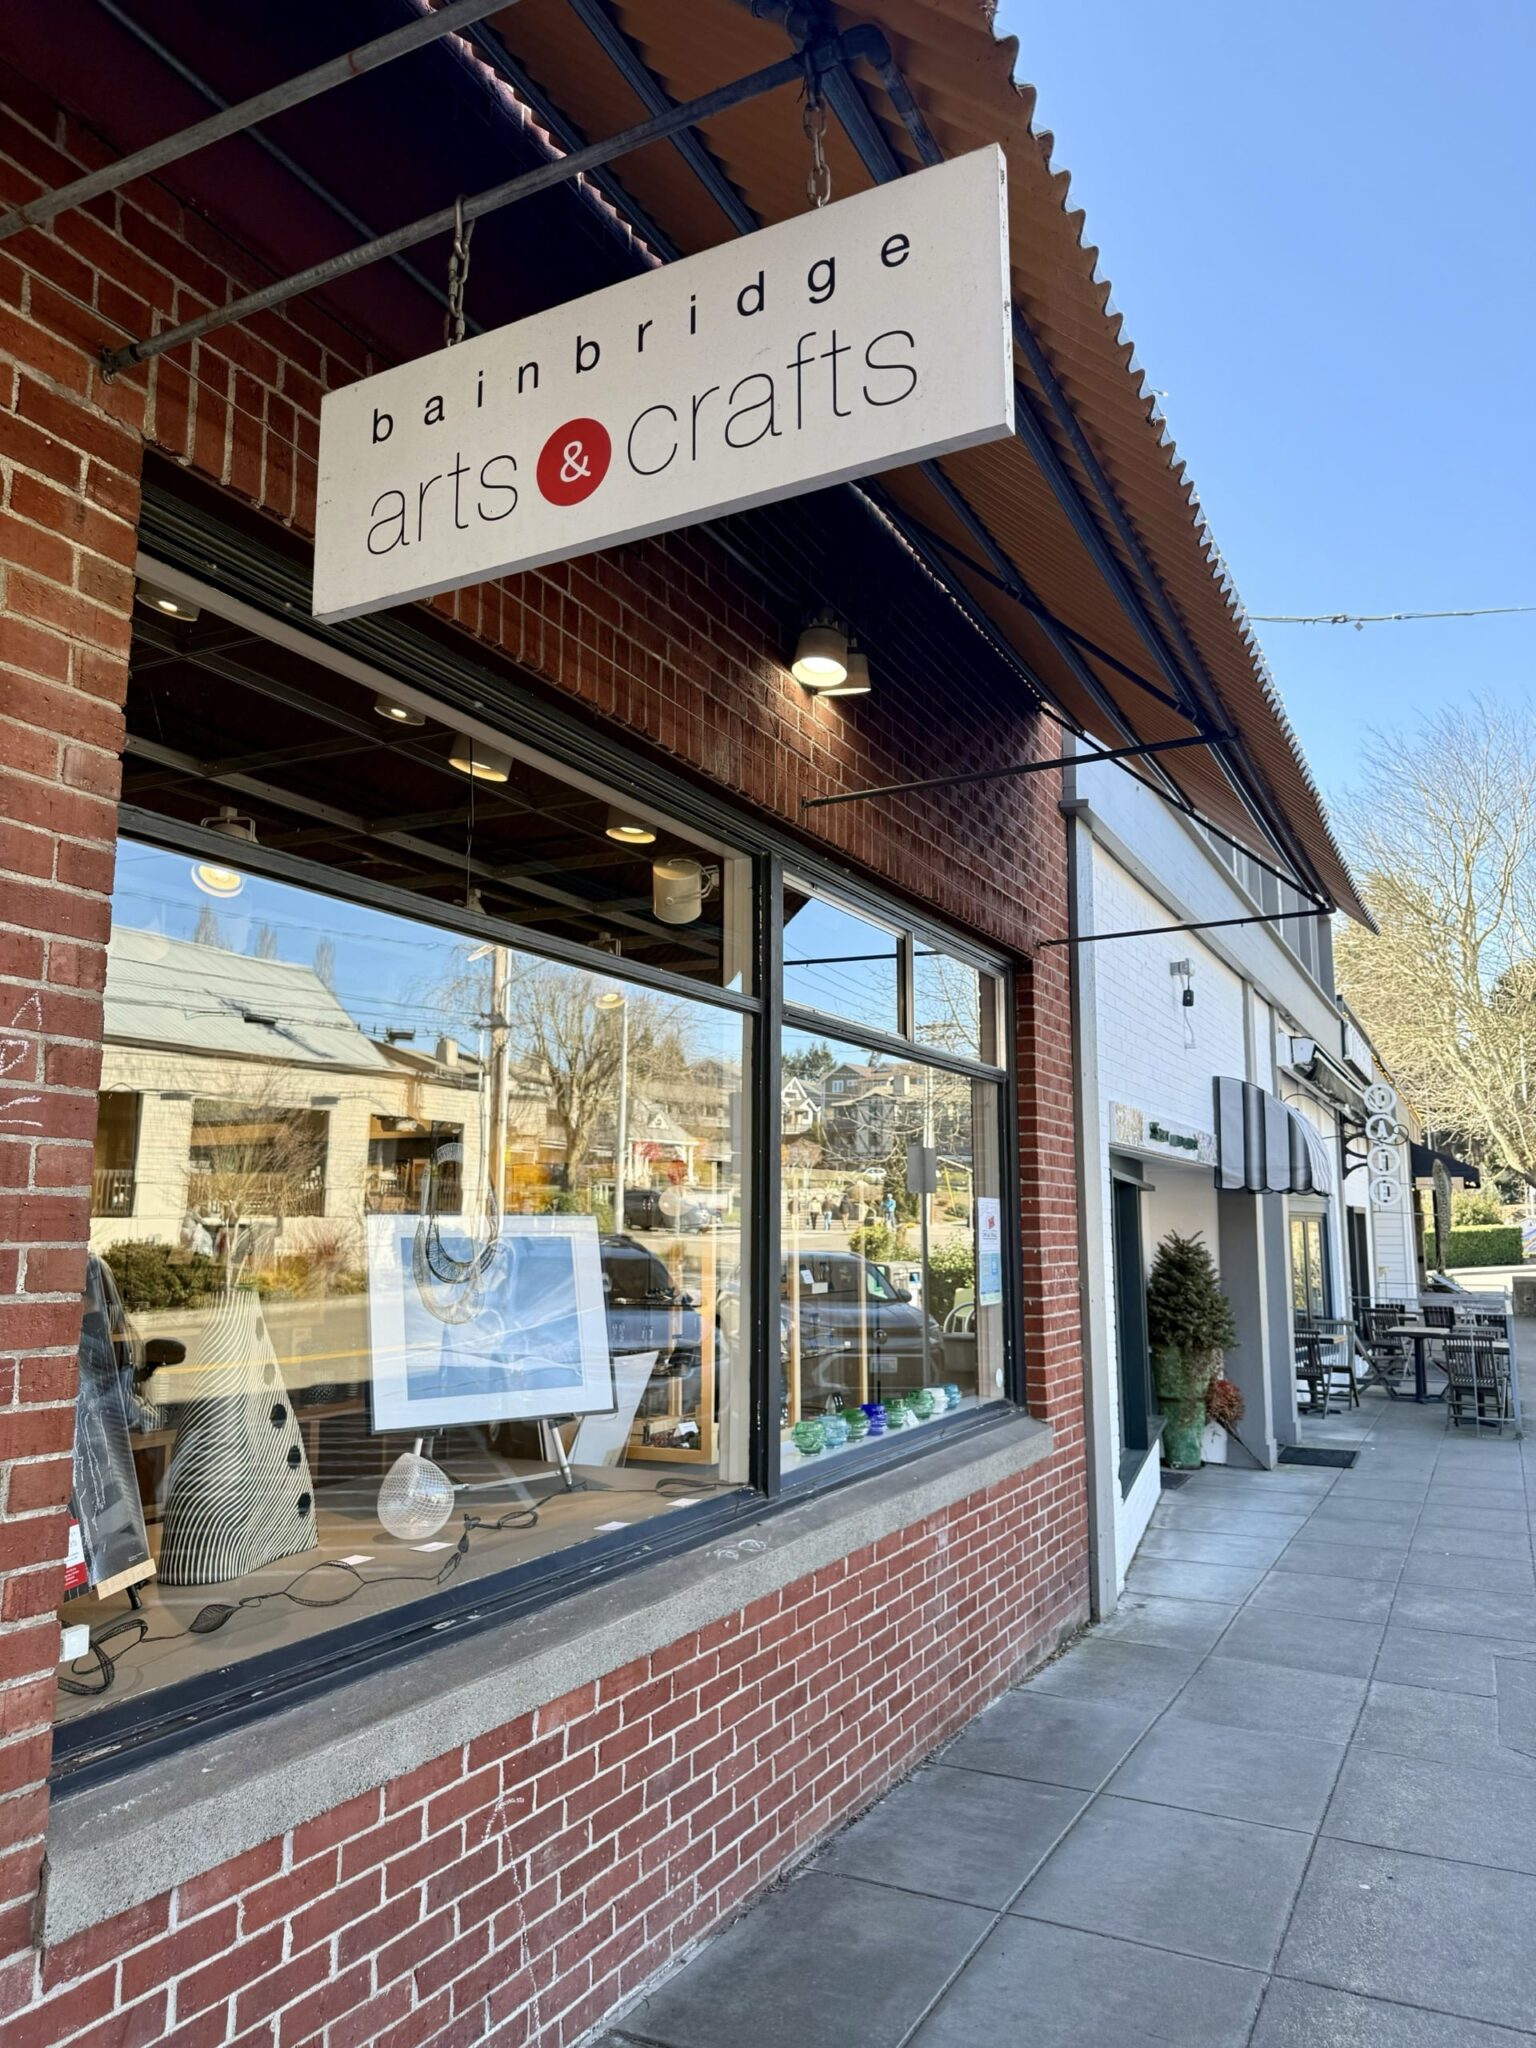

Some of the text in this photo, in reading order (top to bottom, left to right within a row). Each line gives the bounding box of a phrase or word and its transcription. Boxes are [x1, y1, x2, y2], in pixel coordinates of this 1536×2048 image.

[366, 329, 919, 556] arts & crafts
[371, 233, 911, 444] bainbridge
